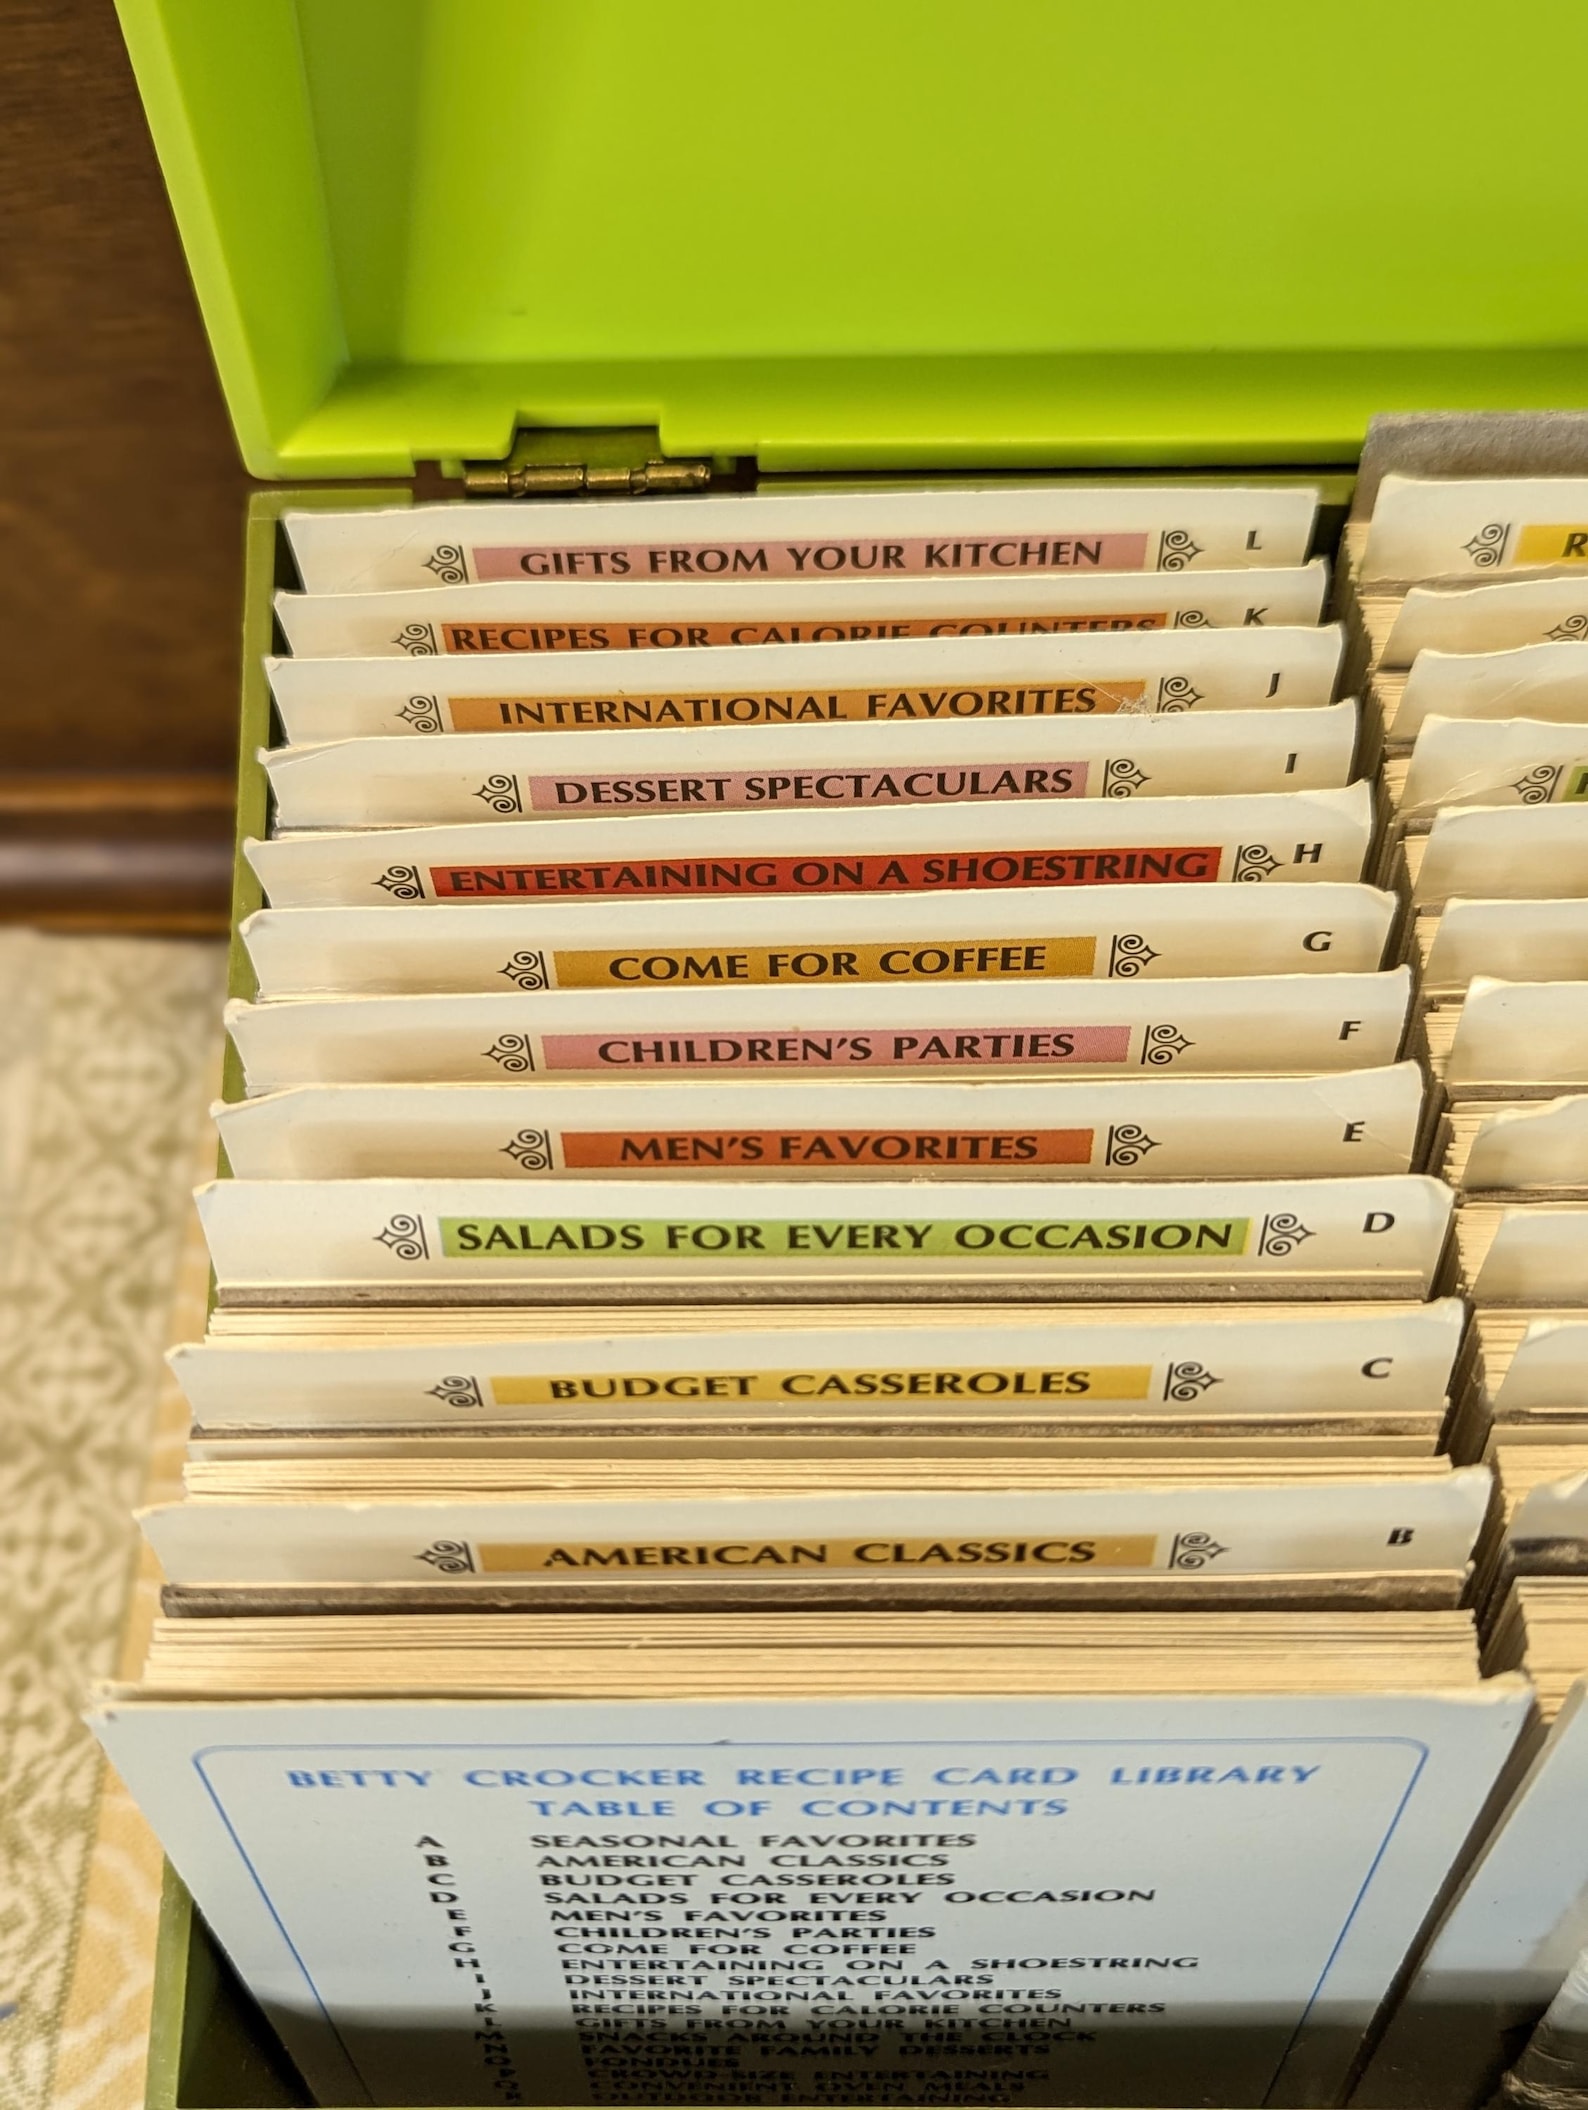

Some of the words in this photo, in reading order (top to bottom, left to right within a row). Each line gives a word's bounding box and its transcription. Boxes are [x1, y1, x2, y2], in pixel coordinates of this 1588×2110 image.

[1247, 531, 1261, 549] L
[521, 552, 630, 575] GIFTS
[649, 549, 768, 573] FROM
[787, 546, 905, 570] YOUR
[926, 542, 1101, 567] KITCHEN
[1244, 608, 1268, 625] K
[452, 629, 609, 650] RECIPES
[628, 628, 711, 648] FOR
[1266, 673, 1280, 697] J
[500, 696, 847, 724] INTERNATIONAL
[868, 688, 1096, 718] FAVORITES
[1286, 754, 1297, 773] I
[556, 779, 731, 803] DESSERT
[745, 769, 1072, 800] SPECTACULARS
[1293, 844, 1322, 863] H
[450, 862, 778, 892] ENTERTAINING
[792, 860, 865, 886] ON
[877, 860, 909, 885] A
[922, 852, 1209, 883] SHOESTRING
[1303, 932, 1332, 951] G
[610, 955, 748, 980] COME
[769, 953, 859, 977] FOR
[880, 947, 1045, 974] COFFEE
[1339, 1021, 1361, 1040] F
[599, 1038, 872, 1063] CHILDREN'S
[894, 1034, 1074, 1059] PARTIES
[1343, 1122, 1365, 1142] E
[621, 1137, 763, 1160] MEN'S
[781, 1137, 1037, 1159] FAVORITES
[1363, 1213, 1394, 1232] D
[458, 1225, 644, 1250] SALADS
[667, 1226, 765, 1250] FOR
[789, 1225, 931, 1249] EVERY
[955, 1224, 1231, 1249] OCCASION
[1362, 1359, 1392, 1378] C
[551, 1377, 756, 1398] BUDGET
[782, 1372, 1089, 1395] CASSEROLES
[1388, 1530, 1413, 1545] B
[544, 1545, 826, 1567] AMERICAN
[854, 1542, 1095, 1563] CLASSICS
[288, 1771, 427, 1786] BETTY
[466, 1770, 703, 1786] CROCKER
[738, 1769, 898, 1786] RECIPE
[934, 1769, 1078, 1784] CARD
[1112, 1767, 1318, 1783] LIBRARY
[535, 1801, 671, 1816] TABLE
[705, 1801, 767, 1816] OF
[802, 1800, 1066, 1816] CONTENTS
[417, 1836, 442, 1847] A
[532, 1836, 735, 1847] SEASONAL
[762, 1835, 975, 1847] FAVORITES
[426, 1856, 448, 1866] B
[538, 1856, 744, 1867] AMERICAN
[771, 1855, 948, 1867] CLASSICS
[428, 1874, 453, 1885] C
[541, 1875, 696, 1886] BUDGET
[721, 1874, 954, 1886] CASSEROLES
[431, 1893, 457, 1902] D
[545, 1893, 687, 1904] SALADS
[711, 1893, 785, 1904] FOR
[811, 1893, 920, 1903] EVERY
[945, 1890, 1154, 1903] OCCASION
[448, 1910, 465, 1919] E
[551, 1911, 662, 1921] MEN'S
[686, 1911, 886, 1921] FAVORITES
[455, 1927, 469, 1936] F
[555, 1928, 770, 1938] CHILDREN'S
[793, 1927, 935, 1938] PARTIES
[449, 1943, 475, 1952] G
[558, 1944, 667, 1954] COME
[690, 1945, 760, 1954] FOR
[784, 1944, 914, 1954] COFFEE
[455, 1959, 480, 1968] H
[562, 1960, 823, 1970] ENTERTAINING
[847, 1961, 902, 1970] ON
[926, 1960, 948, 1969] A
[972, 1958, 1197, 1969] SHOESTRING
[476, 1974, 484, 1983] I
[565, 1975, 707, 1985] DESSERT
[729, 1975, 993, 1985] SPECTACULARS
[483, 1989, 491, 2000] J
[570, 1990, 848, 2000] INTERNATIONAL
[875, 1990, 1061, 2000] FAVORITES
[473, 2003, 497, 2013] K
[572, 2003, 701, 2014] RECIPES
[721, 2003, 791, 2014] FOR
[810, 2003, 960, 2014] CALORIE
[978, 2003, 1166, 2014] COUNTERS
[484, 2017, 502, 2027] L
[575, 2018, 666, 2028] GIFTS
[683, 2018, 786, 2028] FROM
[806, 2018, 902, 2028] YOUR
[924, 2018, 1072, 2028] KITCHEN
